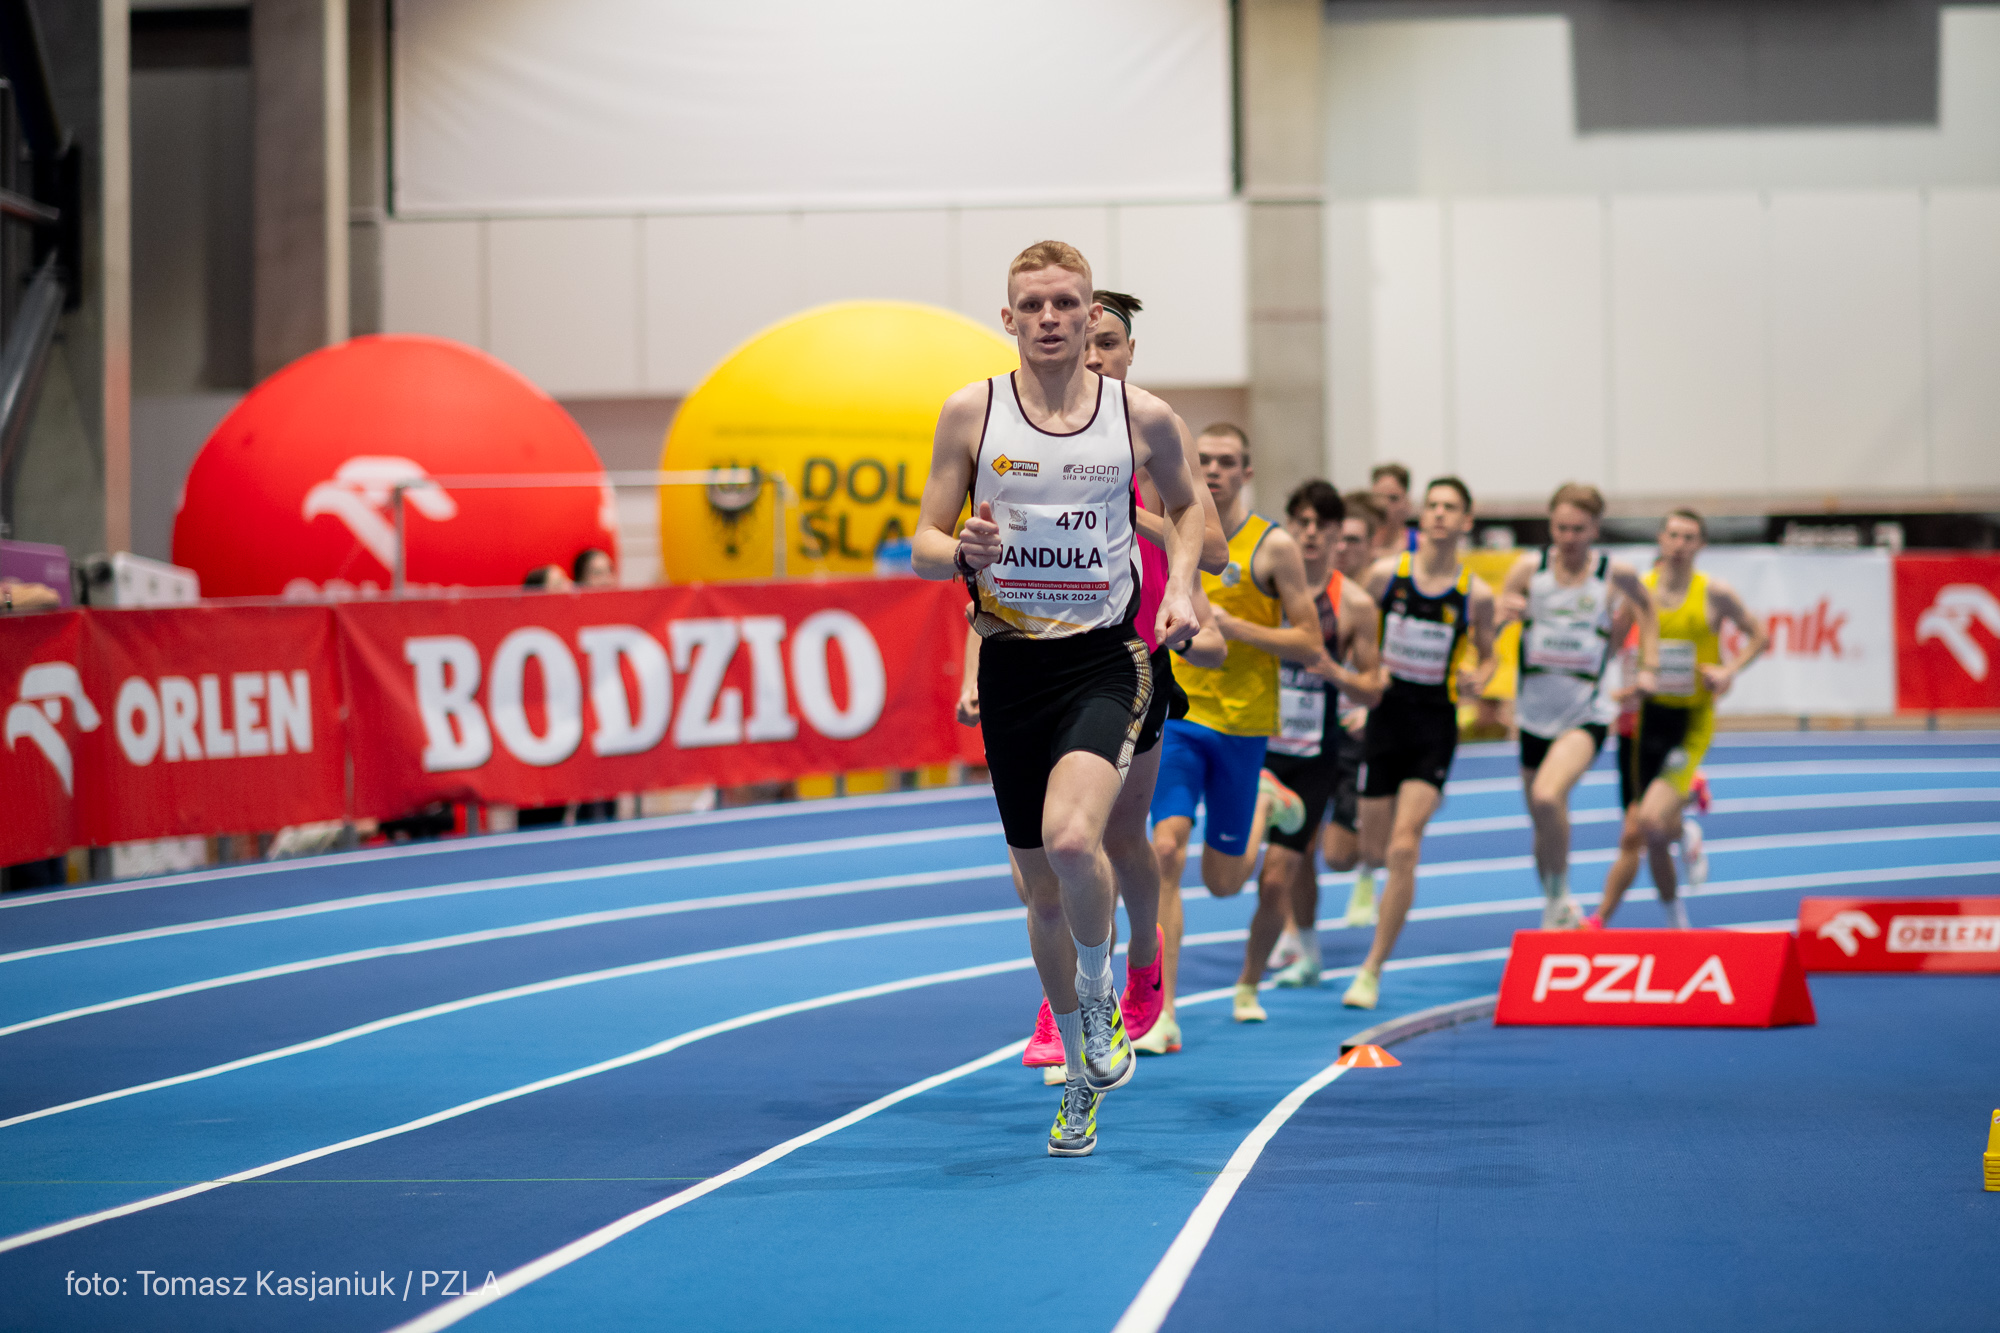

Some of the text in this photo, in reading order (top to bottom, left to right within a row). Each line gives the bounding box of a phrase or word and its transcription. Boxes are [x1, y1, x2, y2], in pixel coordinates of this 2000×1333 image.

[802, 457, 922, 506] DOL
[1012, 462, 1038, 471] OPTIMA
[1089, 475, 1119, 485] precyzji
[1055, 510, 1097, 531] 470
[1037, 590, 1069, 602] ŚLĄSK
[1071, 593, 1097, 601] 2024
[404, 608, 888, 773] BODZIO
[115, 669, 313, 767] ORLEN
[1532, 954, 1736, 1005] PZLA
